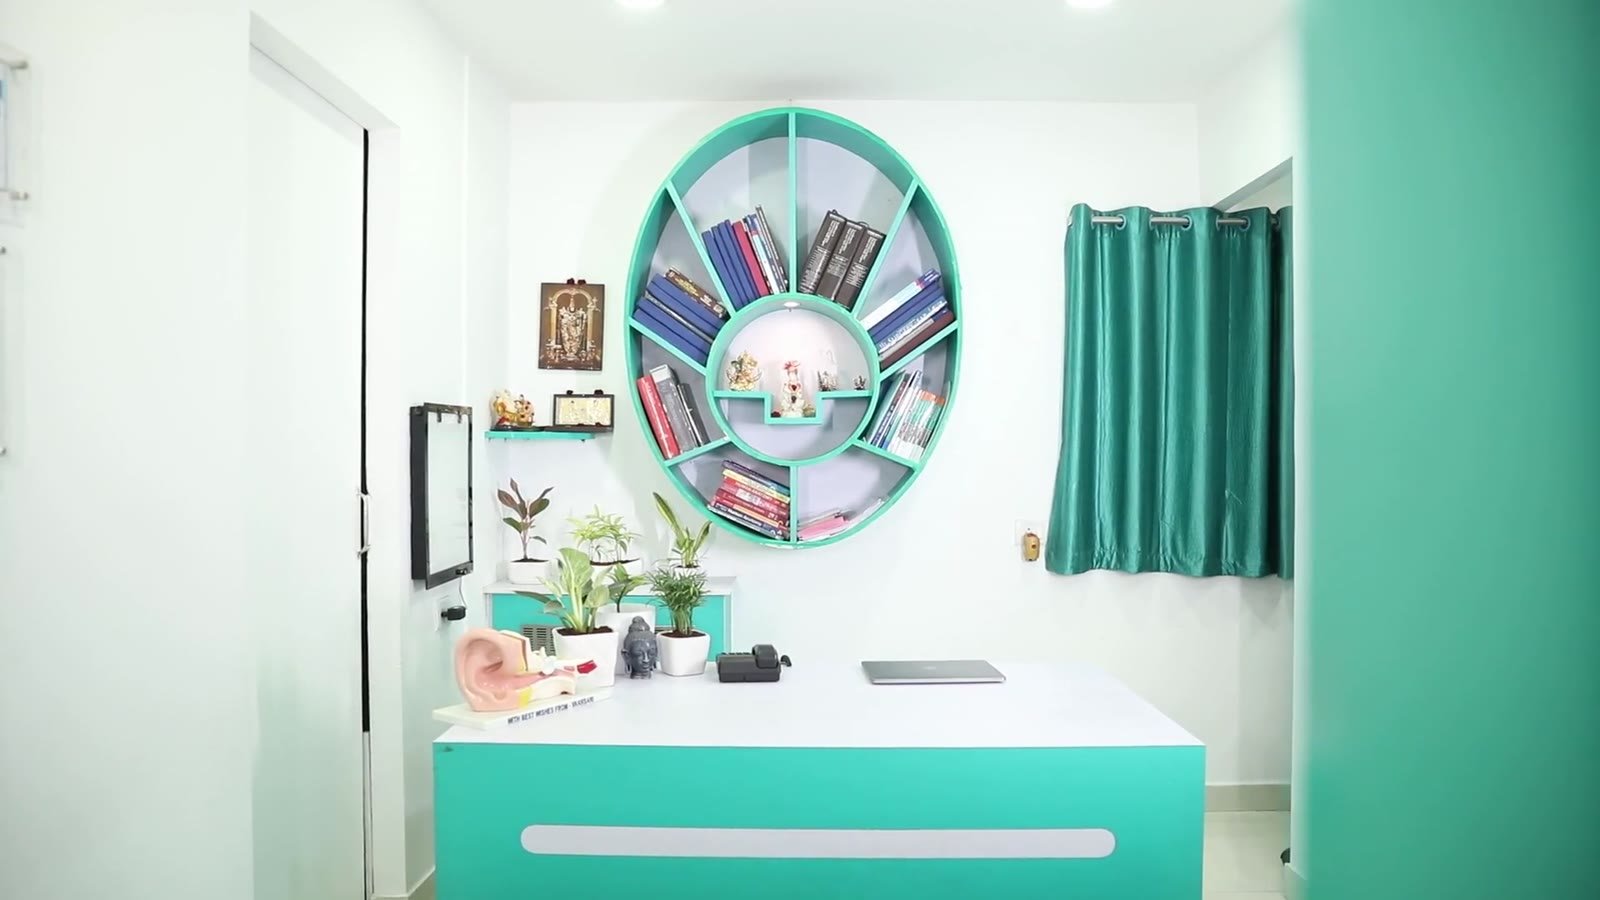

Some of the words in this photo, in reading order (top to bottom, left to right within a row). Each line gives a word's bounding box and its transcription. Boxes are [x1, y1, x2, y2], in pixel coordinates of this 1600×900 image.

[521, 712, 534, 721] BEST
[535, 706, 554, 717] WISHES
[555, 703, 568, 712] FROM
